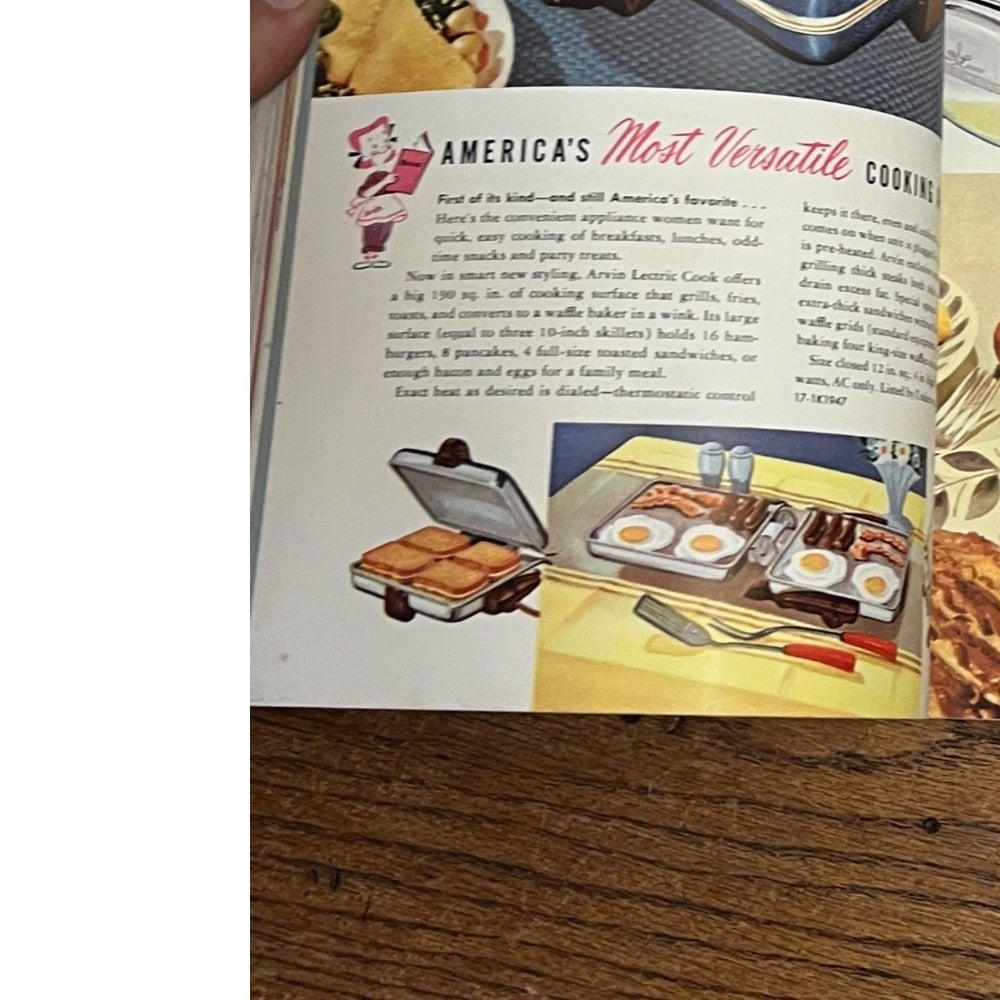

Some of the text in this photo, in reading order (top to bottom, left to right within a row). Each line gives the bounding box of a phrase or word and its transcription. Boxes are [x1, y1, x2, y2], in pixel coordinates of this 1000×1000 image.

[441, 117, 934, 204] AMERICA'S Most Versatile COOKING
[436, 192, 738, 207] First of its kind—and still America's favorite
